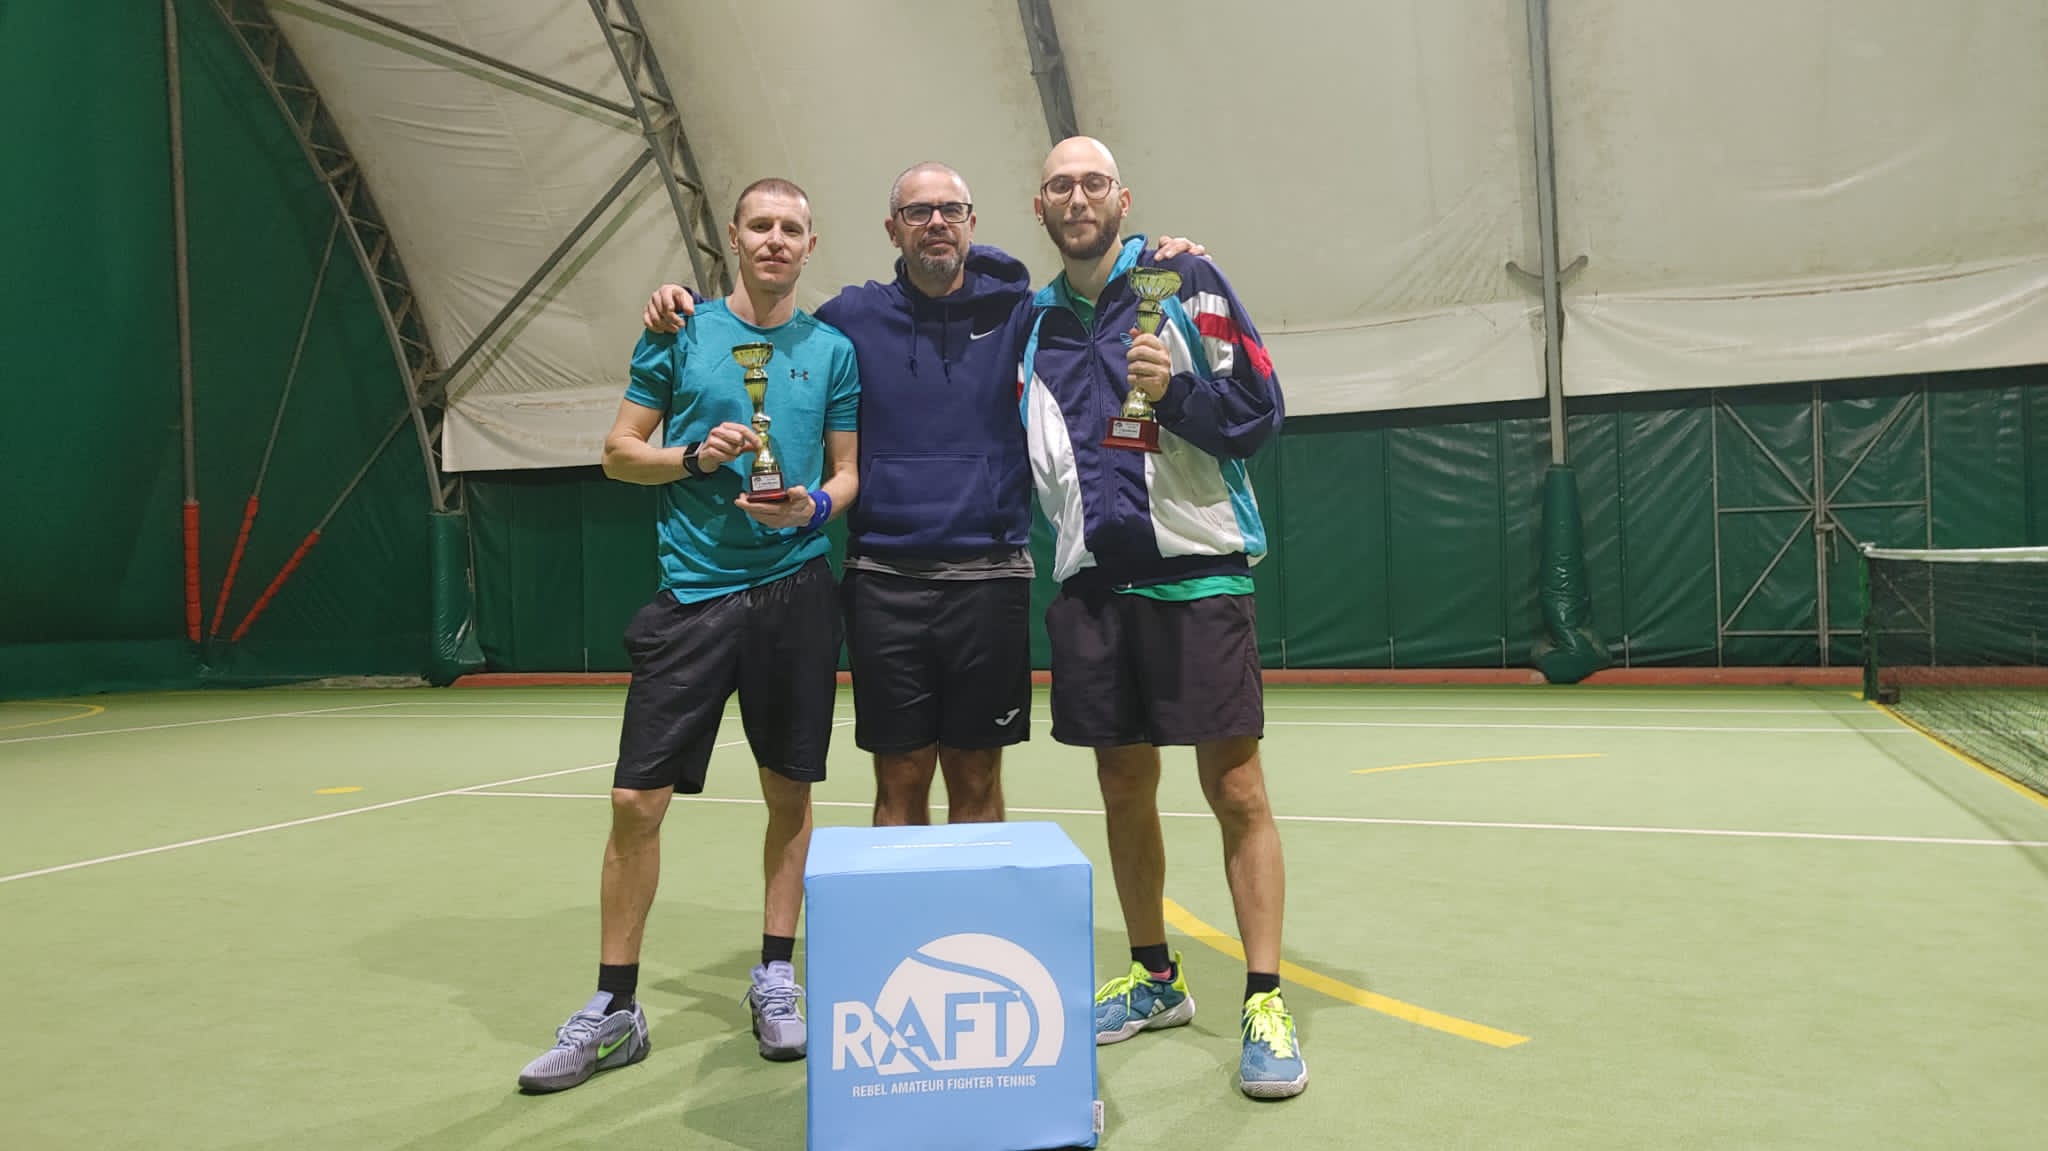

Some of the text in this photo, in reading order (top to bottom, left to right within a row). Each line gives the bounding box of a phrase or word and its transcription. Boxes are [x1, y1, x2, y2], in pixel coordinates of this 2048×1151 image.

[832, 991, 1021, 1070] RAFT
[852, 1073, 1037, 1097] REBEL AMATEUR FIGHTER TENNIS
